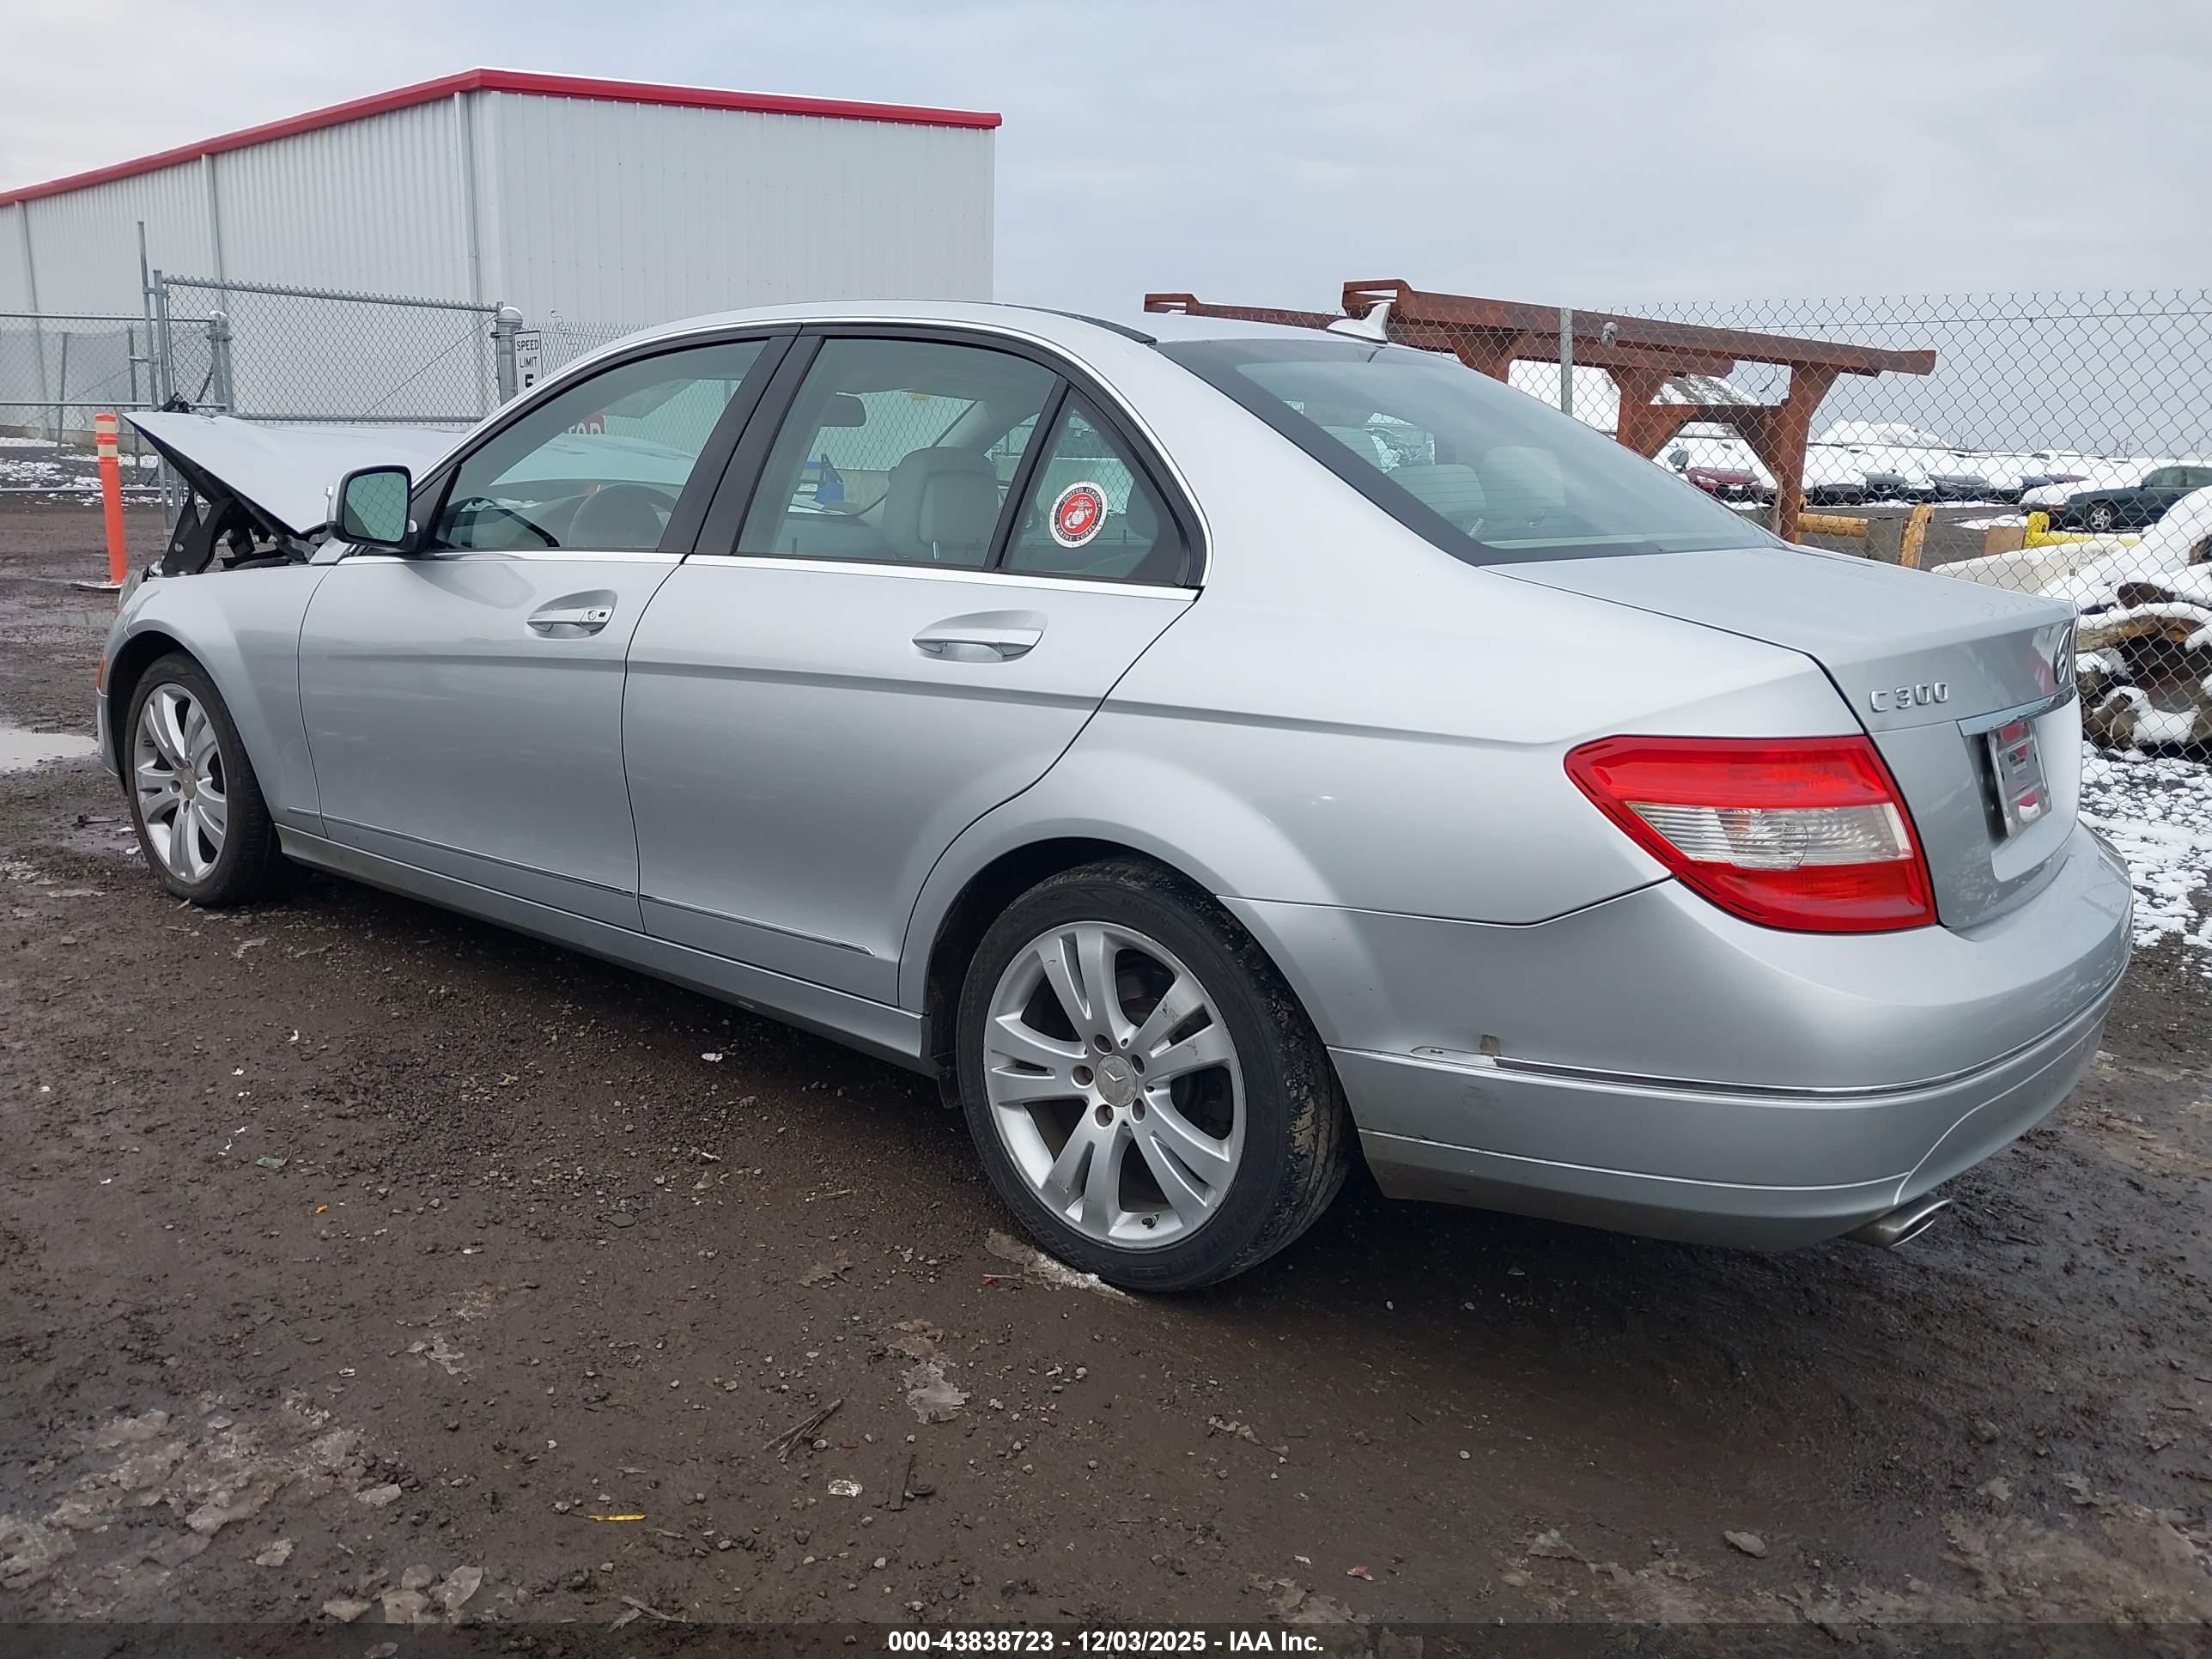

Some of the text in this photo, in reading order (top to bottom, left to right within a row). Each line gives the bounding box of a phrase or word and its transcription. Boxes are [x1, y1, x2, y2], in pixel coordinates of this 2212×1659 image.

[516, 339, 539, 351] SPEED
[520, 356, 538, 368] LIMIT
[1062, 487, 1085, 502] UNITED
[1055, 523, 1074, 542] MARINE
